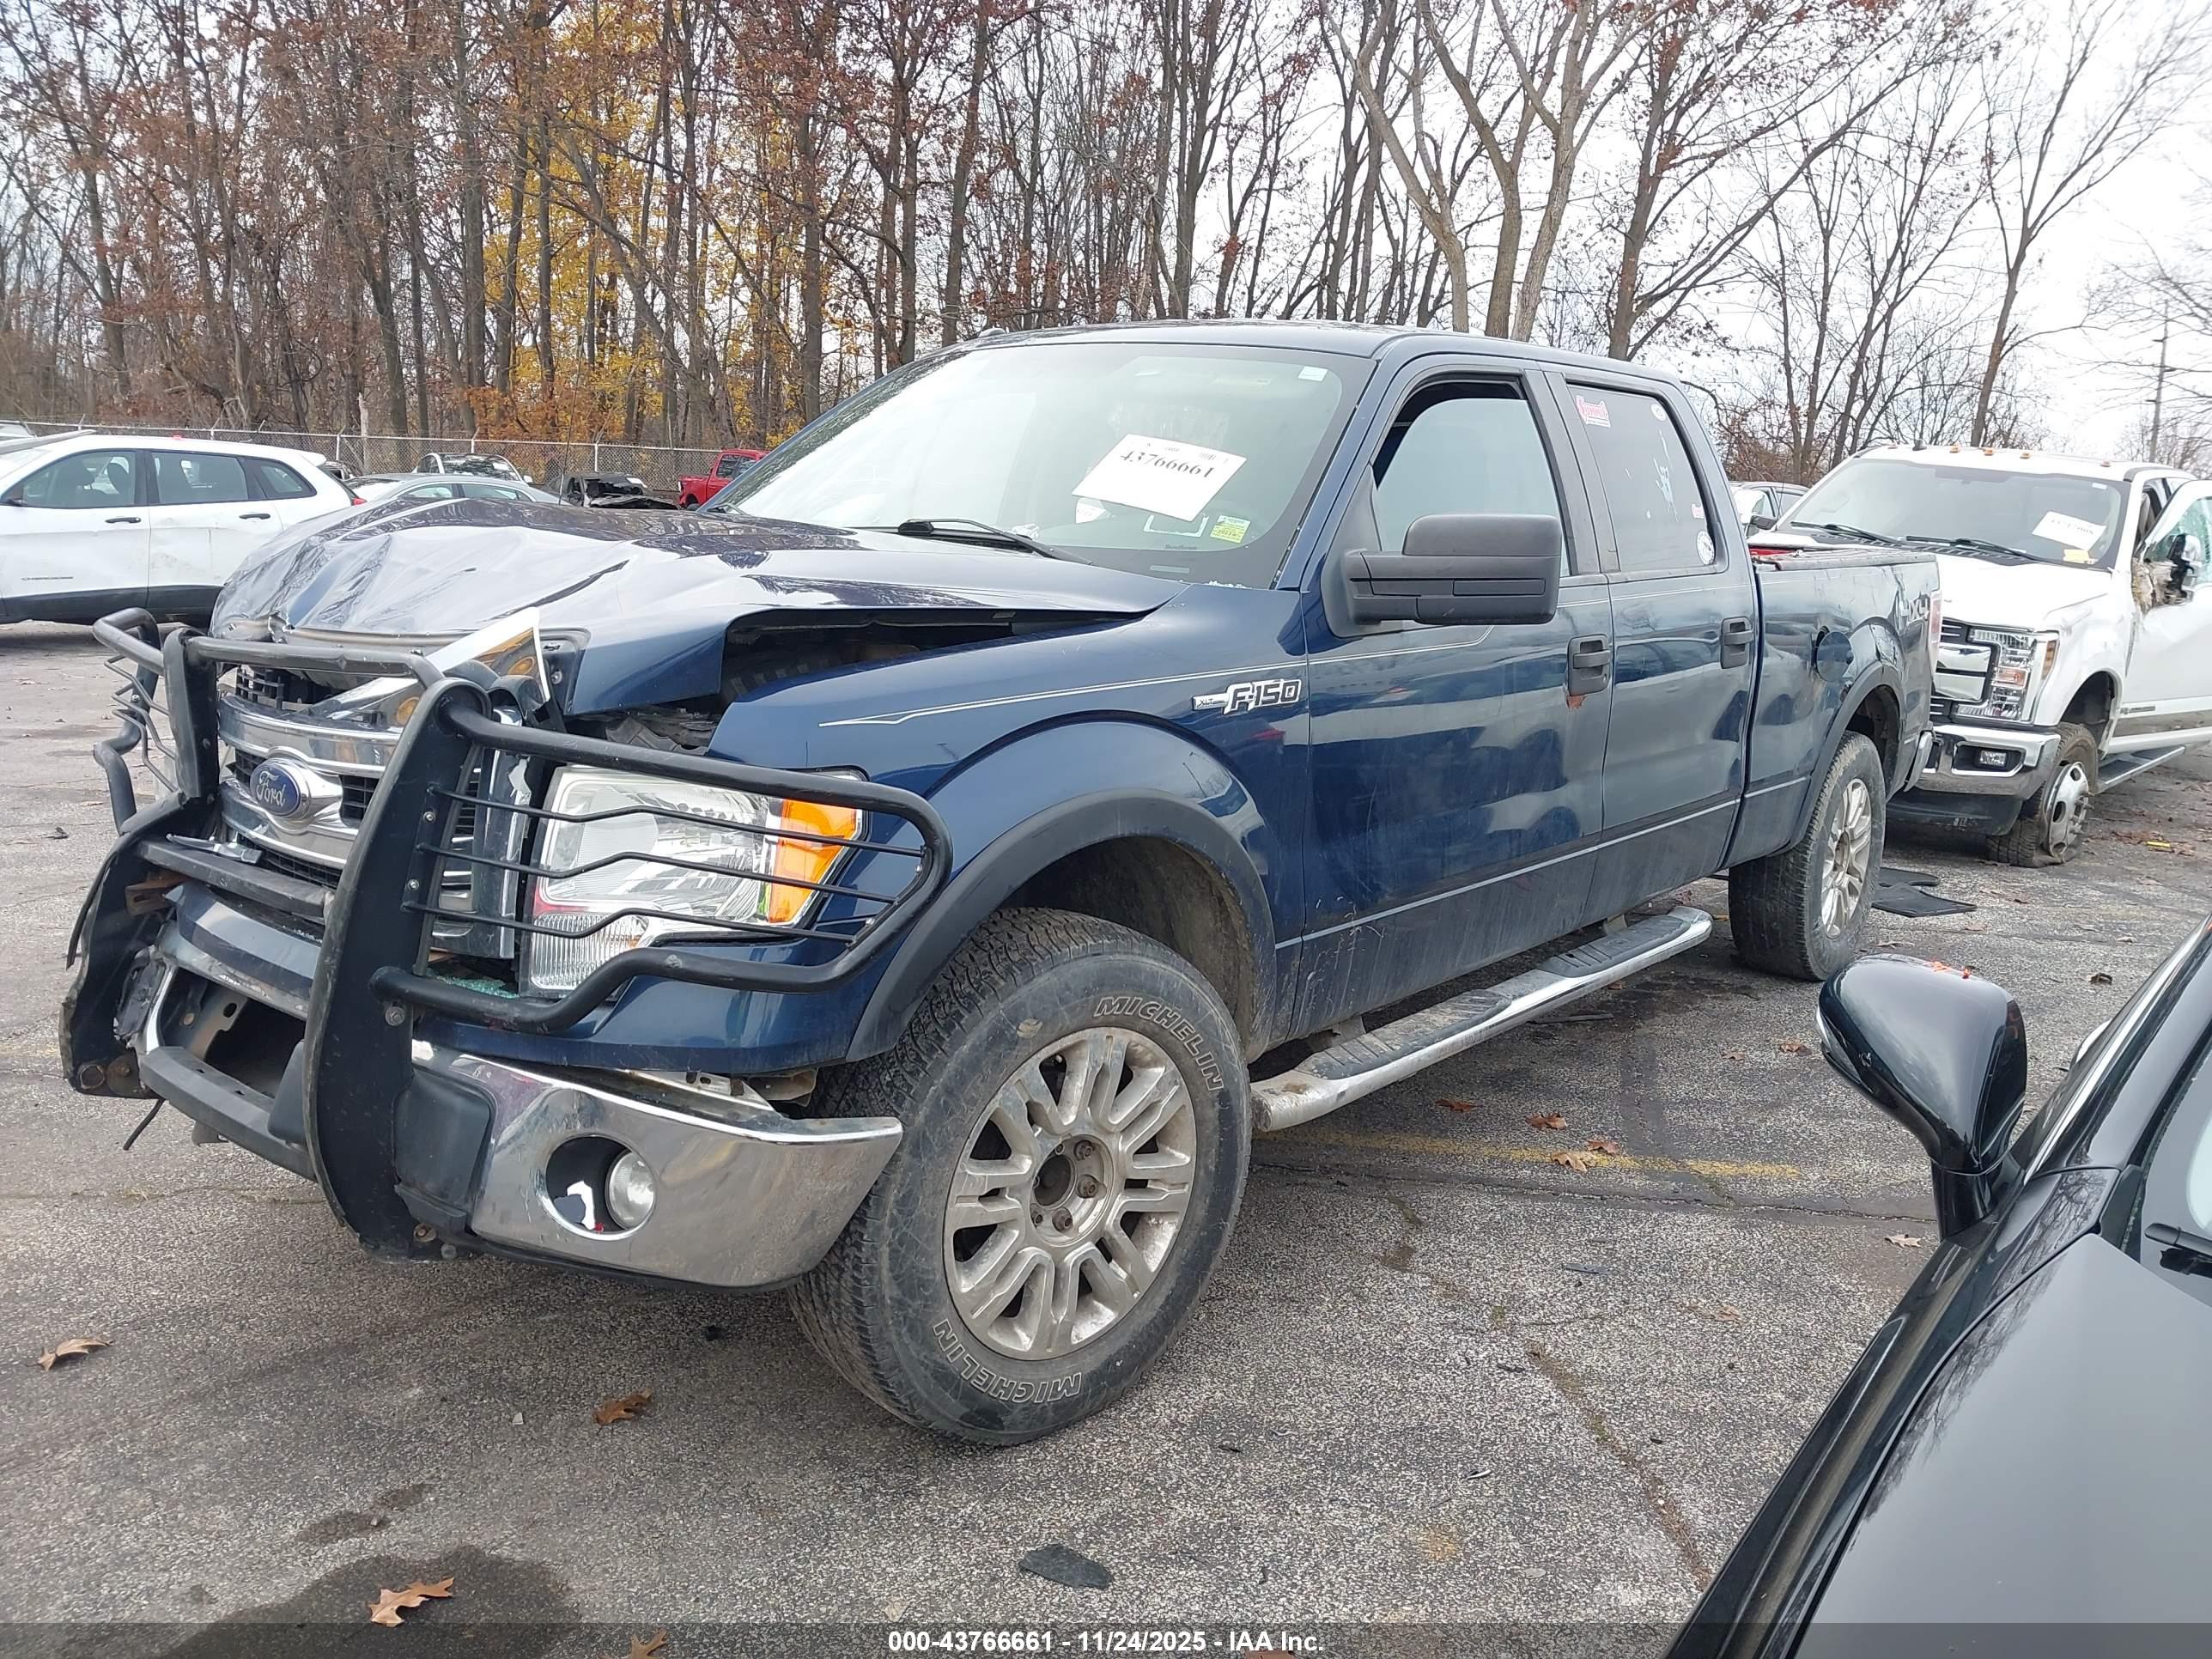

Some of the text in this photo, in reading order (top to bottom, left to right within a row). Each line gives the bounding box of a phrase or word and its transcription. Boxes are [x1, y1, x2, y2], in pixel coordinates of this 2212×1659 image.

[1120, 450, 1215, 478] 43766661
[1224, 680, 1301, 714] F-150
[256, 769, 287, 807] Ford
[1093, 996, 1224, 1091] MICHELIN
[933, 1317, 1082, 1404] MICHELIN
